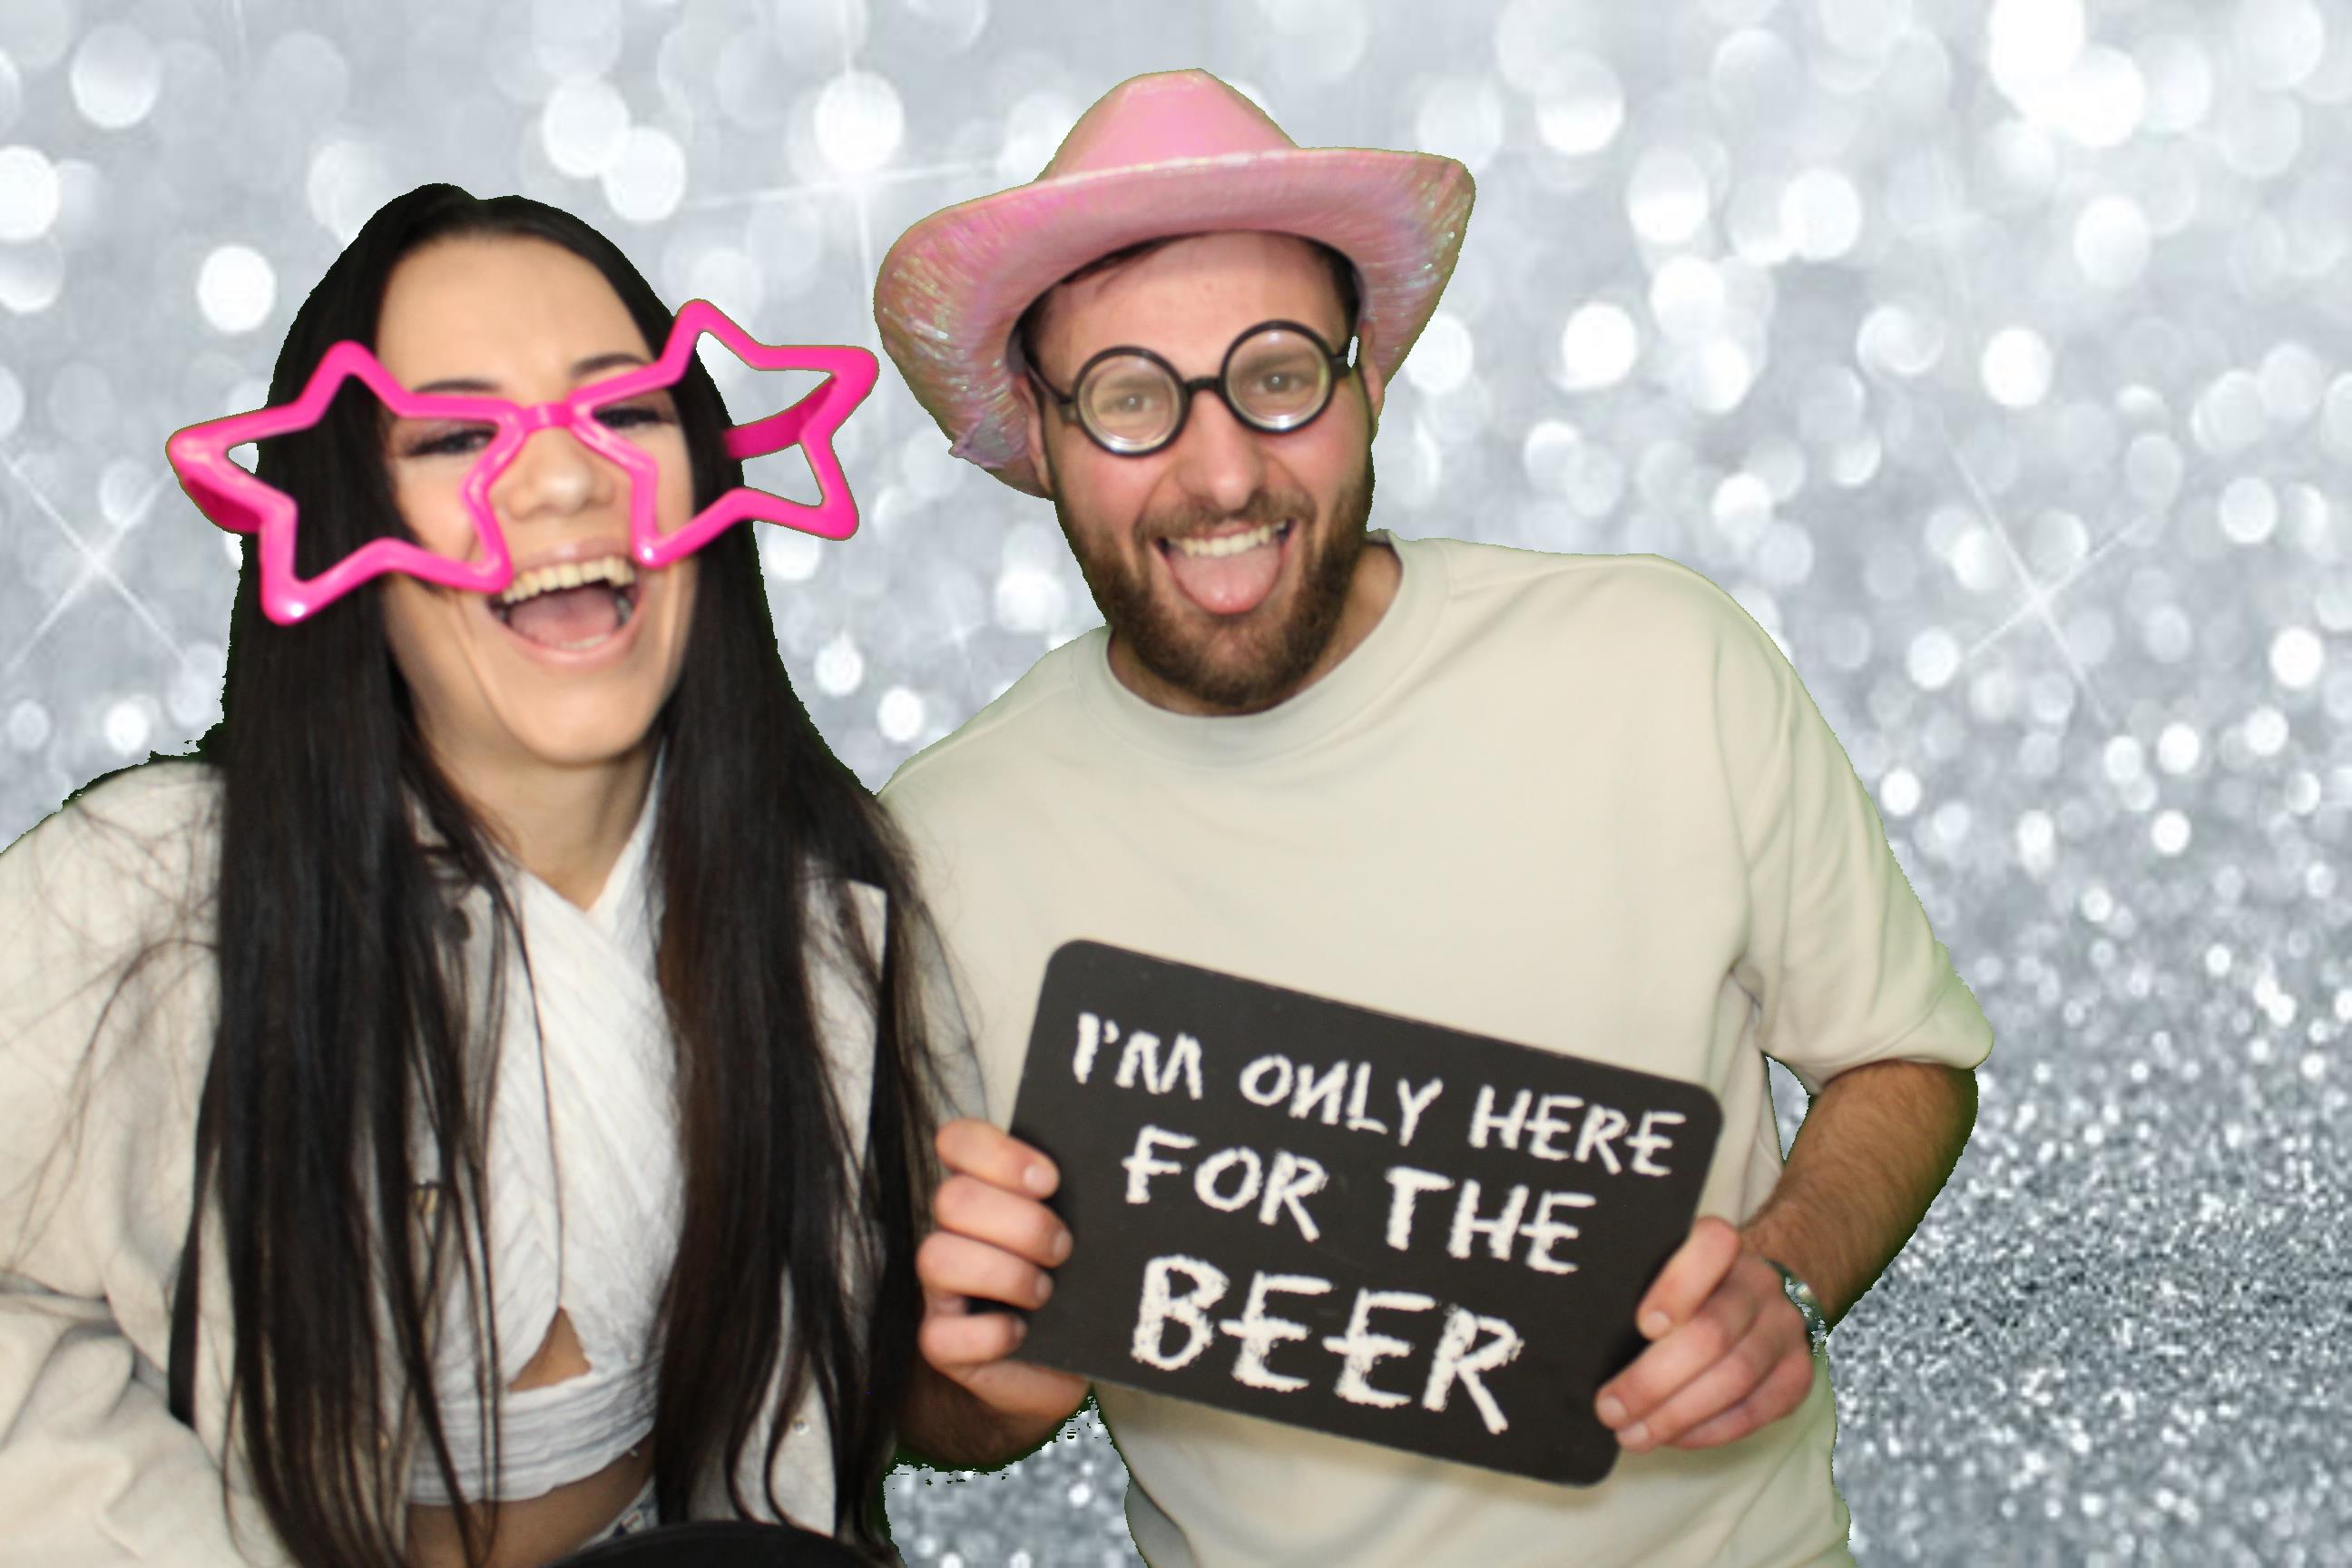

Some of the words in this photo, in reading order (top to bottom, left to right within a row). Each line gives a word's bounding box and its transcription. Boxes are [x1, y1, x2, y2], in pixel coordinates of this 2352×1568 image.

[1073, 1013, 1203, 1099] I'M
[1240, 1055, 1444, 1146] ONLY
[1469, 1085, 1686, 1176] HERE
[1122, 1125, 1329, 1241] FOR
[1387, 1167, 1596, 1274] THE
[1132, 1255, 1524, 1434] BEER
